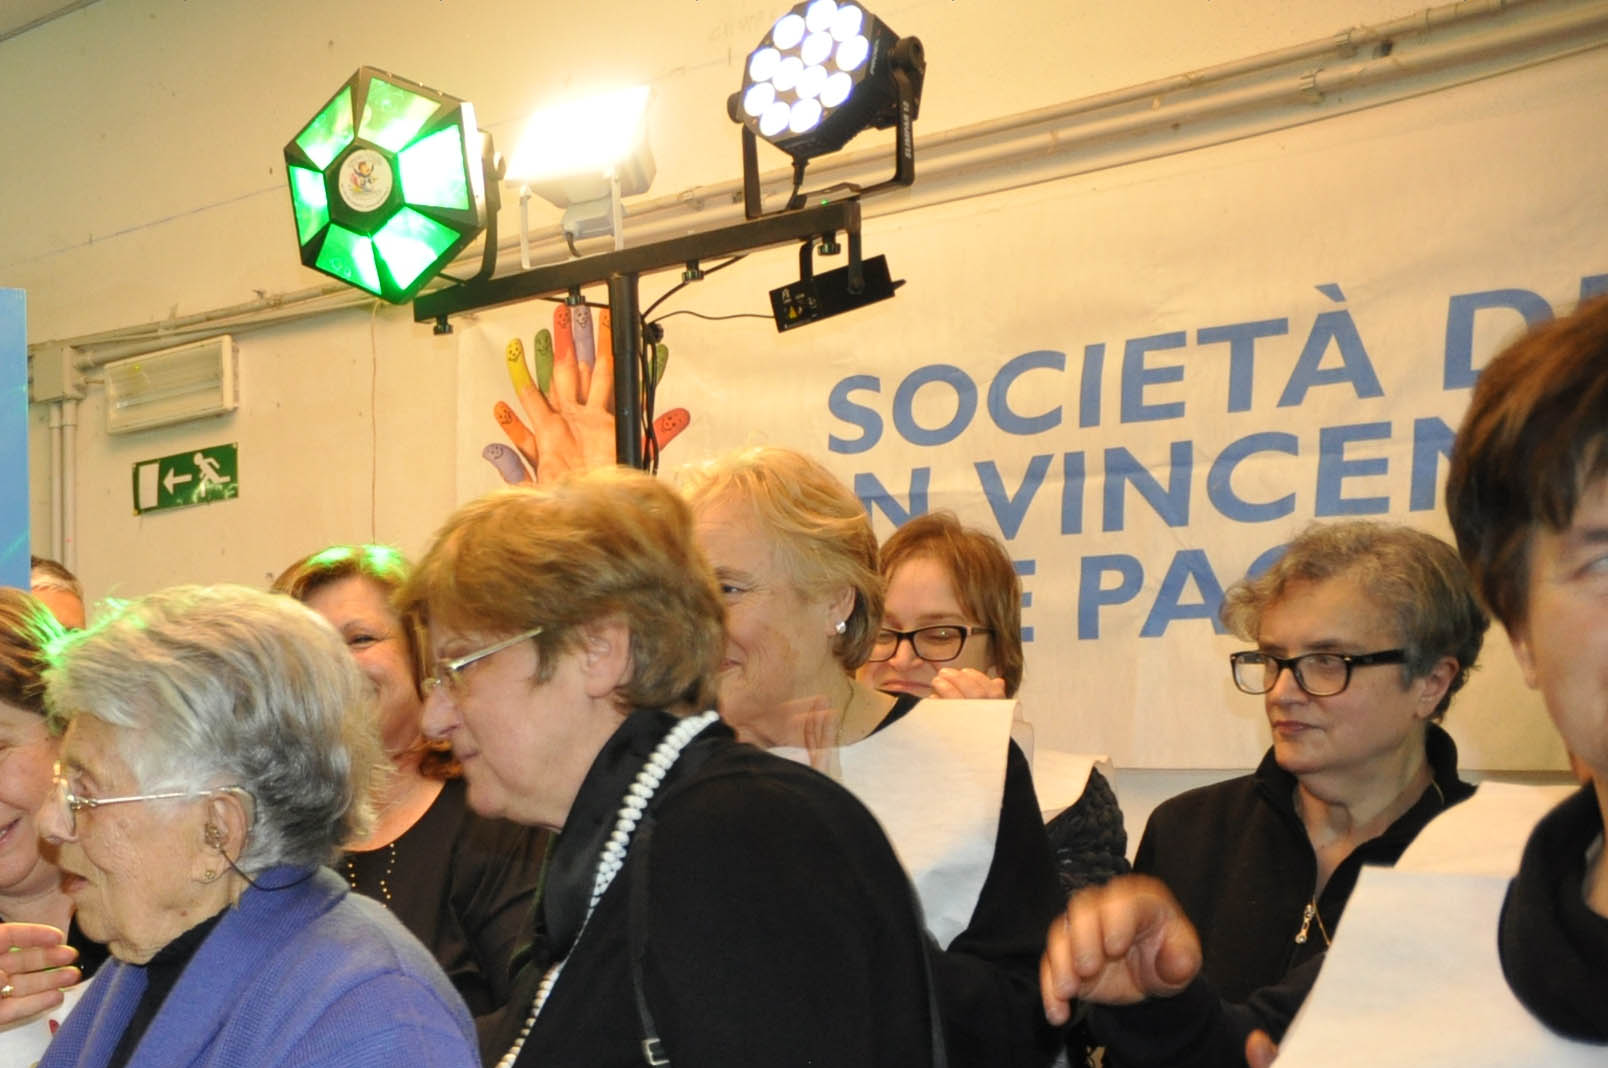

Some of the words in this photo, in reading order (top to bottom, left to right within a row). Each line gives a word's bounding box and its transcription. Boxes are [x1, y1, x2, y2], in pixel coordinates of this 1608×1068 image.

[827, 283, 1384, 455] SOCIETÀ
[974, 416, 1458, 541] VINCEN
[1078, 543, 1290, 640] PA
